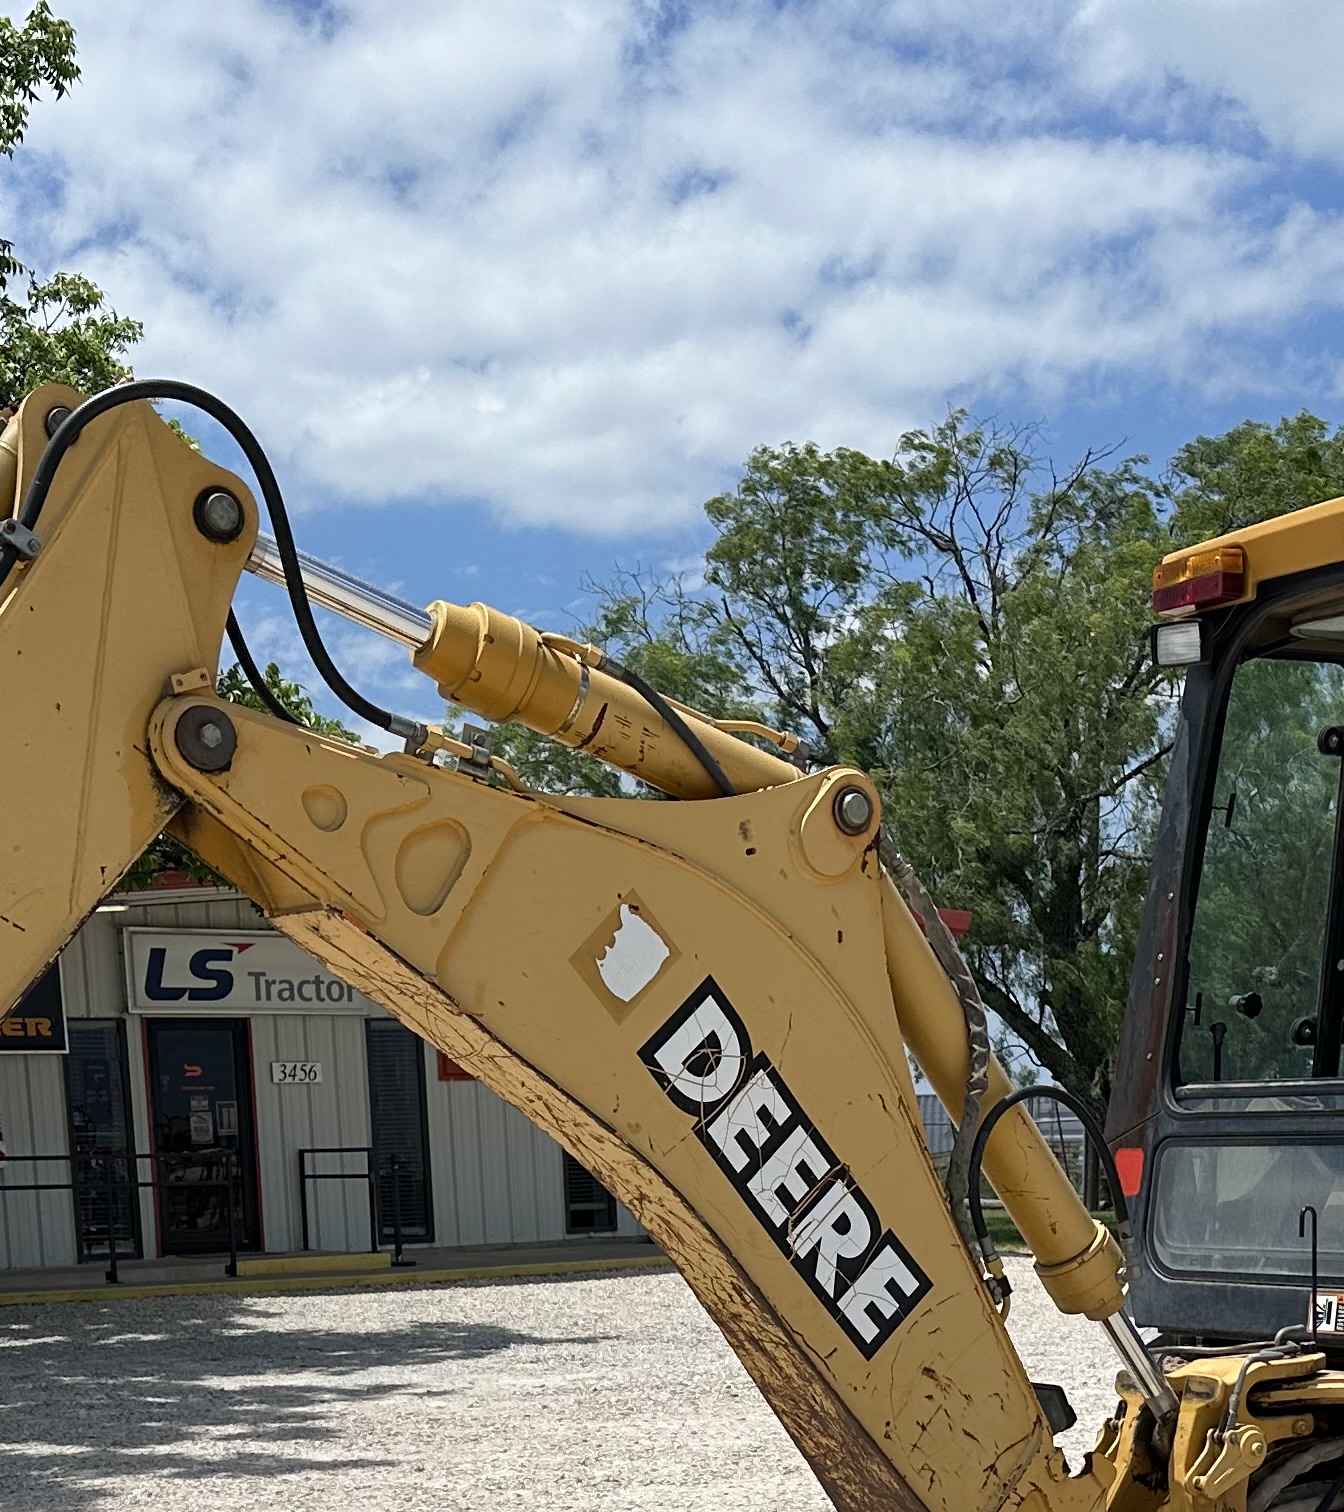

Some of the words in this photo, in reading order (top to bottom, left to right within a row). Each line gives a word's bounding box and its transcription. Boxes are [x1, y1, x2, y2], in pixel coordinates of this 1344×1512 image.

[144, 947, 234, 1001] LS
[277, 1063, 318, 1082] 3456
[652, 993, 920, 1345] DEERE
